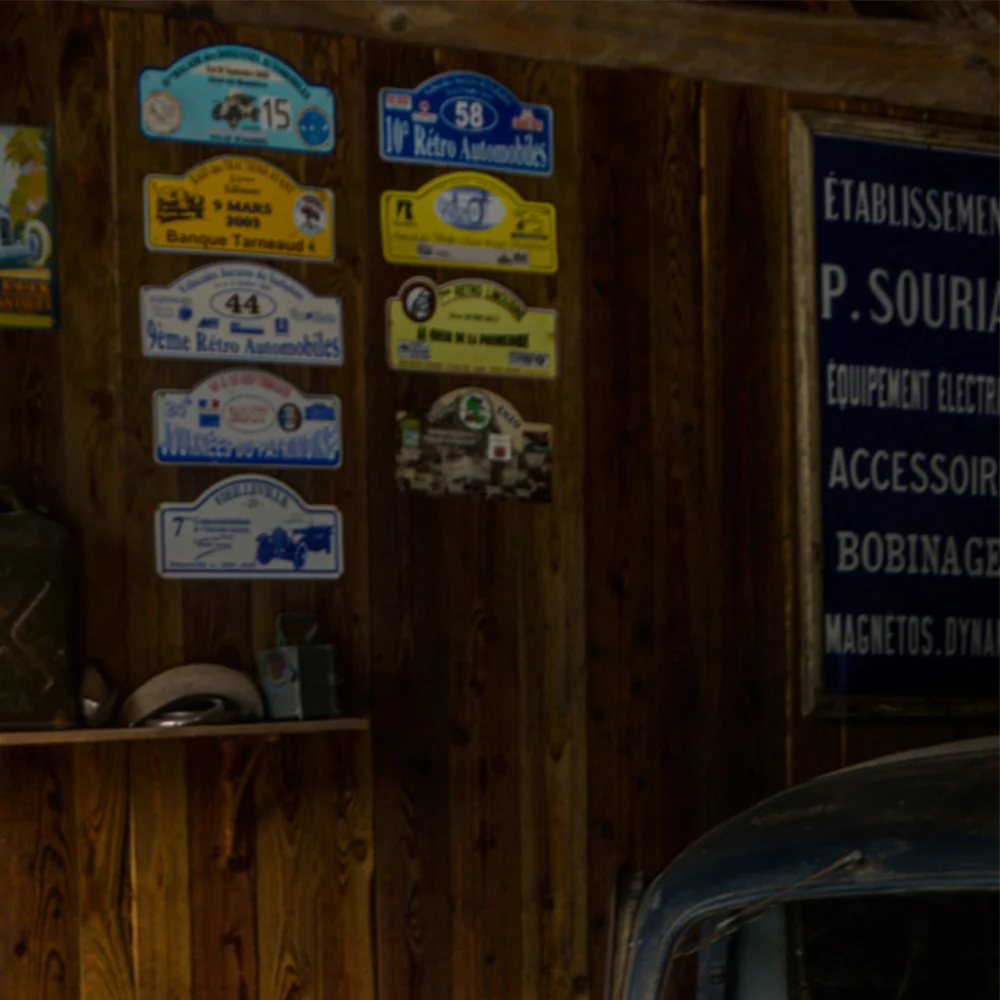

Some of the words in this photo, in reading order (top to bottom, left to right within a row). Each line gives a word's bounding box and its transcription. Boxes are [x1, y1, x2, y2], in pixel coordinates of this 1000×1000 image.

[261, 98, 292, 131] 15
[454, 101, 484, 130] 58
[226, 199, 273, 215] MARS
[166, 229, 227, 248] Banque
[224, 293, 260, 315] 44
